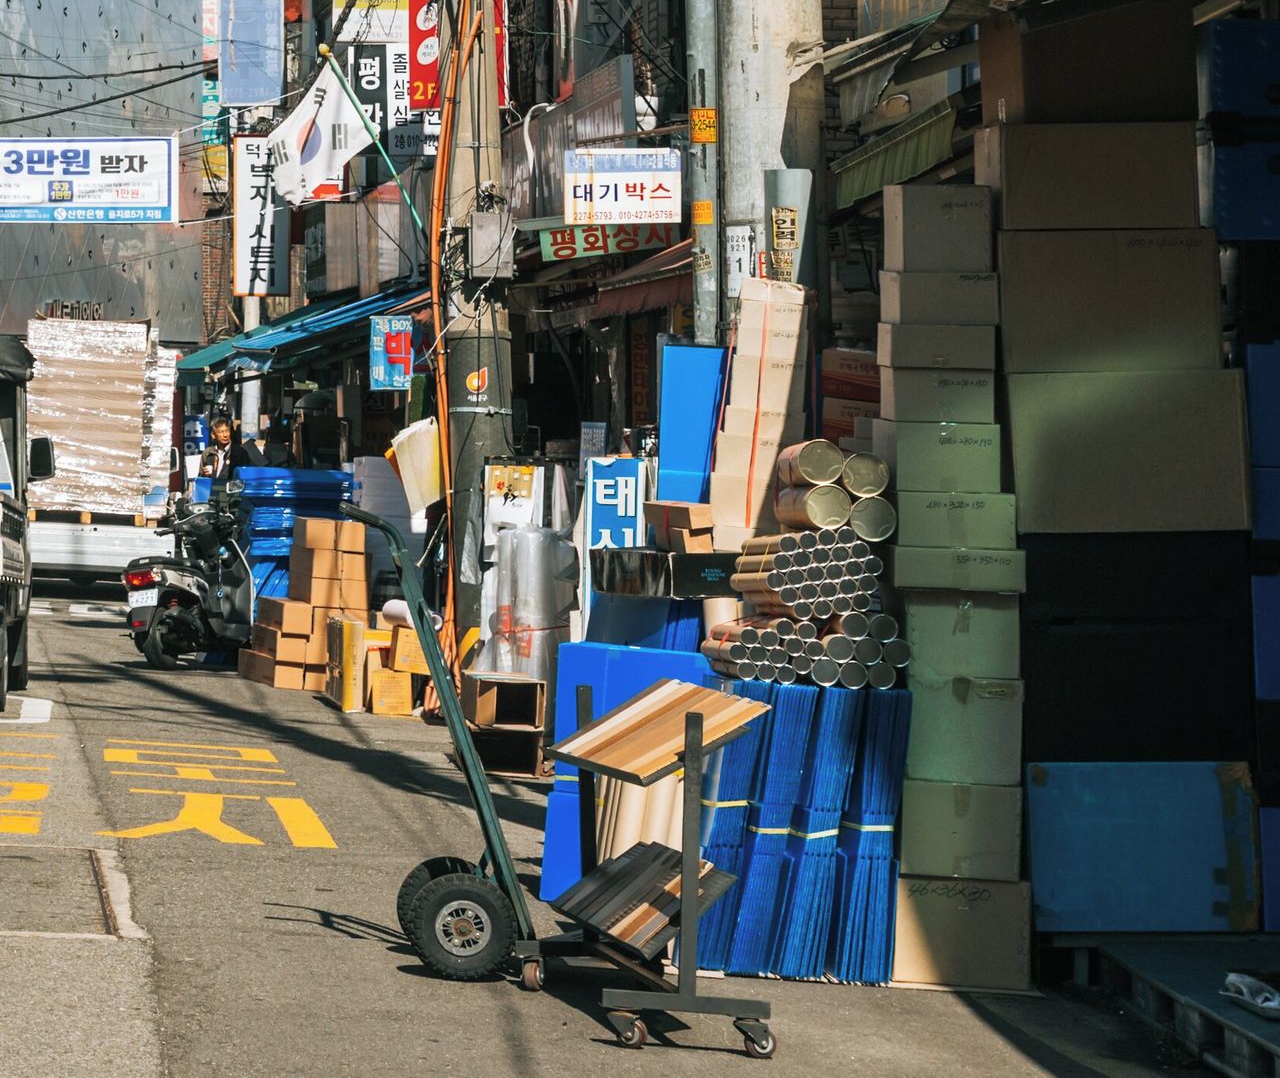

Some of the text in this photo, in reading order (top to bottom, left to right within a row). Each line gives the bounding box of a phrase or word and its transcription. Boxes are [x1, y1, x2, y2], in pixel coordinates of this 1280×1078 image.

[3, 149, 91, 176] 3만원
[100, 154, 149, 174] 받자
[573, 183, 673, 203] 대기박스
